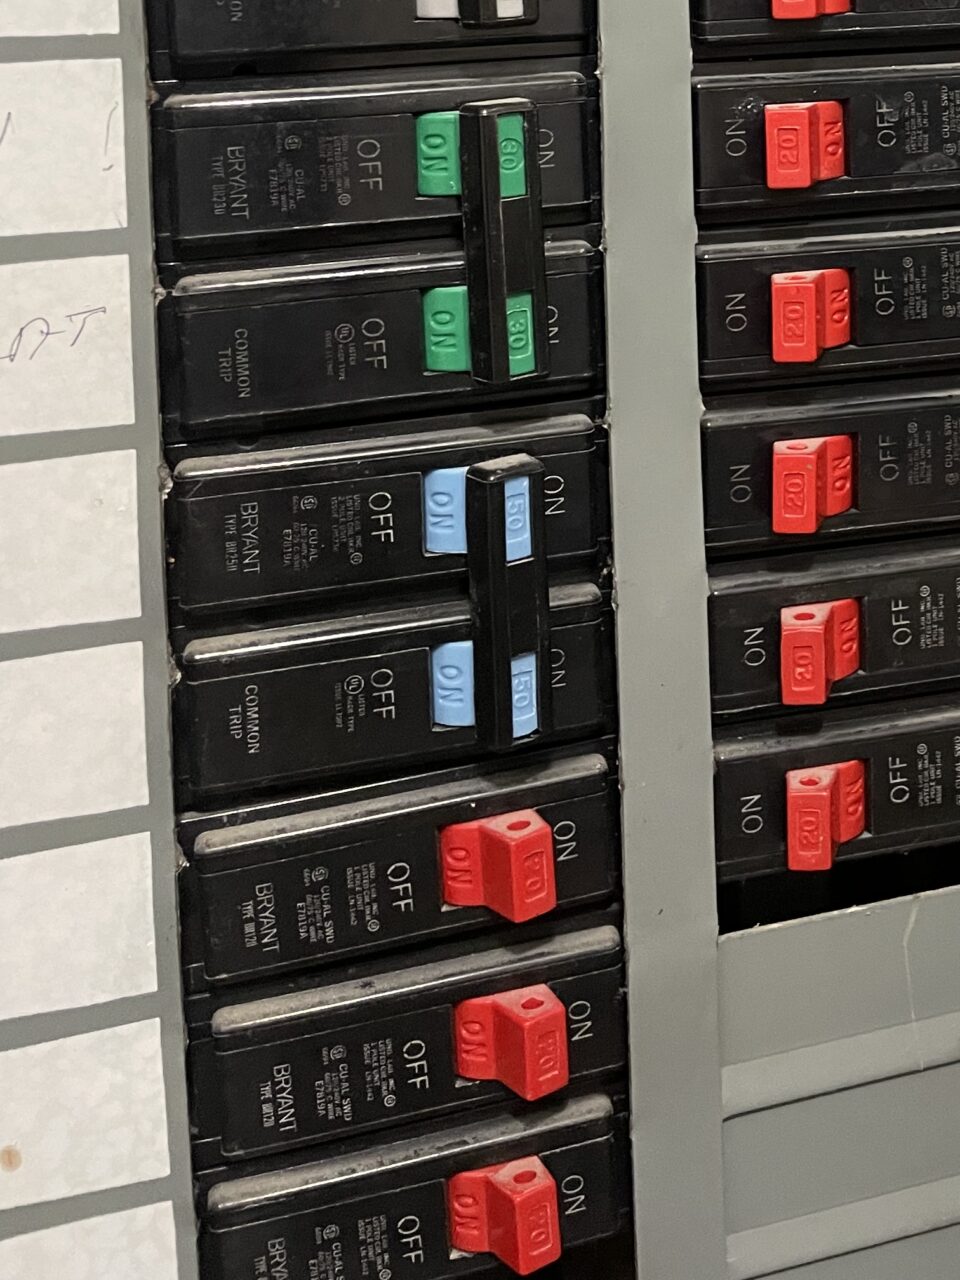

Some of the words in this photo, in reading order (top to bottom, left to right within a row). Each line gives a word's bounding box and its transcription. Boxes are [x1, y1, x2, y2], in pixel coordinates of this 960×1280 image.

[725, 118, 748, 157] ON
[876, 99, 897, 147] OFF
[356, 139, 383, 192] OFF
[778, 134, 798, 165] 20
[226, 145, 249, 220] BRYANT
[725, 293, 748, 332] ON
[874, 268, 895, 316] OFF
[361, 318, 388, 369] OFF
[508, 321, 526, 349] 30
[218, 347, 232, 383] TRIP
[235, 328, 251, 399] COMMON
[879, 434, 900, 482] OFF
[543, 475, 566, 515] ON
[729, 464, 751, 503] ON
[784, 478, 803, 509] 20
[239, 501, 261, 574] BRYANT
[368, 492, 394, 544] OFF
[506, 499, 522, 530] 50
[891, 599, 913, 646] OFF
[743, 626, 766, 666] ON
[370, 668, 396, 720] OFF
[513, 676, 530, 708] 50
[228, 704, 242, 740] TRIP
[244, 685, 259, 754] COMMON
[889, 757, 910, 803] OFF
[740, 793, 764, 834] ON
[799, 816, 817, 846] 20
[553, 821, 578, 862] ON
[386, 862, 414, 913] OFF
[255, 882, 280, 953] BRYANT
[568, 1000, 593, 1042] ON
[402, 1039, 429, 1090] OFF
[272, 1063, 298, 1132] BRYANT
[561, 1174, 586, 1215] ON
[397, 1214, 424, 1264] OFF
